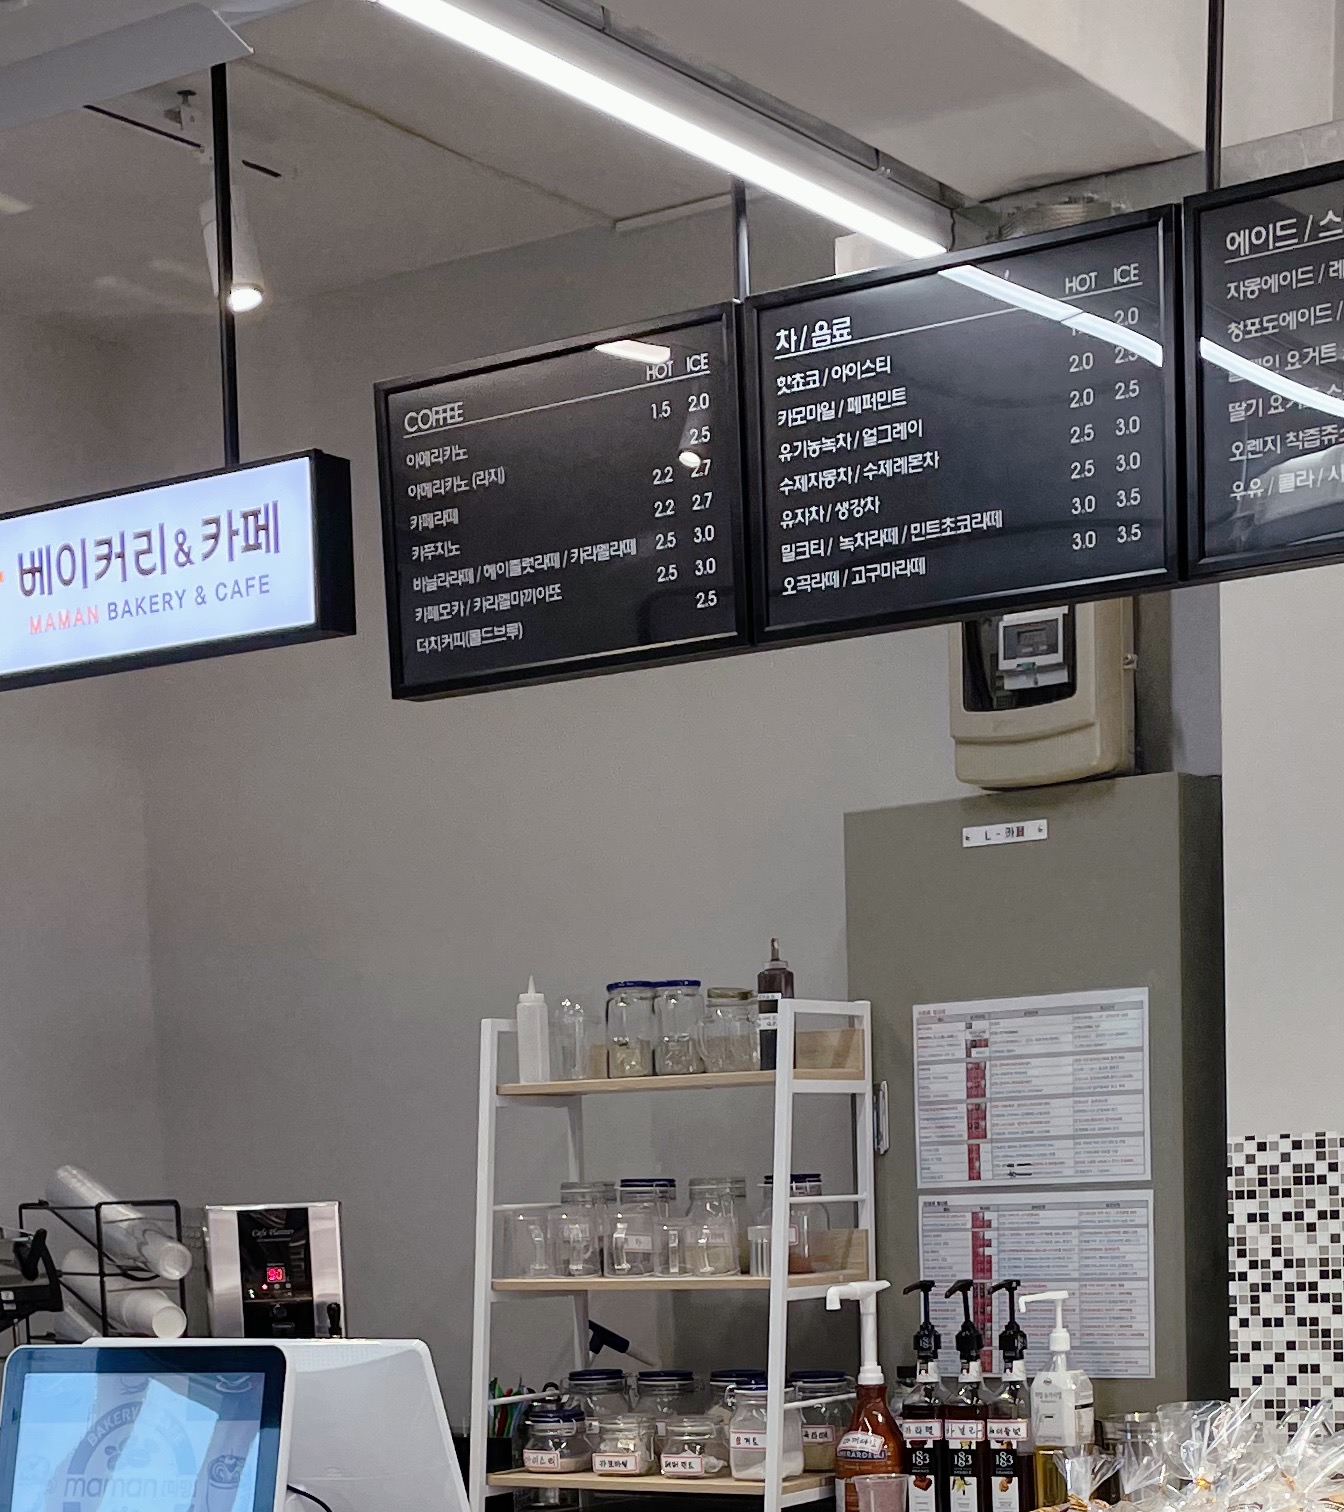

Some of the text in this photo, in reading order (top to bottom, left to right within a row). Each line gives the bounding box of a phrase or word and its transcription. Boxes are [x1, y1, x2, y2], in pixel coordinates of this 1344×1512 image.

[1225, 217, 1299, 256] 에이드
[1065, 264, 1140, 295] HOT ICE
[1226, 265, 1314, 301] 자몽에이드
[776, 316, 852, 354] 차 음료
[1227, 302, 1333, 343] 청포도에이드
[646, 353, 709, 381] HOT ICE
[831, 355, 892, 382] 아이스티
[1069, 353, 1094, 374] 2.0
[1285, 342, 1338, 373] 요거트
[688, 393, 710, 413] 2.0
[777, 387, 907, 428] 카모마일 페퍼민트
[1070, 380, 1141, 409] 2.0 2.5
[404, 402, 464, 433] COFFEE
[1228, 398, 1263, 423] 딸기
[689, 427, 711, 445] 2.5
[778, 418, 924, 461] 유기농녹차 얼그레이
[1070, 416, 1141, 444] 2.5 3.0
[406, 444, 468, 469] 아메리카노
[1229, 435, 1282, 463] 오렌지
[653, 467, 674, 485] 2.2
[779, 450, 940, 496] 수제자몽차 수제레몬차
[1071, 452, 1142, 479] 2.5 3.0
[408, 476, 470, 501] 아메리카노
[1071, 488, 1142, 515] 3.0 3.5
[1229, 477, 1264, 501] 우유
[654, 493, 713, 518] 2.2 2.7
[780, 495, 881, 531] 유자차 생강차
[18, 501, 280, 597] 베이커리&카페
[656, 525, 715, 550] 2.5 3.0
[781, 510, 1003, 563] 밀크티 녹차라떼 민트초코라떼
[1072, 524, 1143, 551] 3.0 3.5
[657, 558, 717, 583] 2.5 3.0
[782, 556, 927, 597] 오곡라떼 고구마라떼
[29, 573, 271, 635] MAMAN BAKERY & CAFE
[696, 591, 718, 609] 2.5
[64, 1476, 156, 1499] maman
